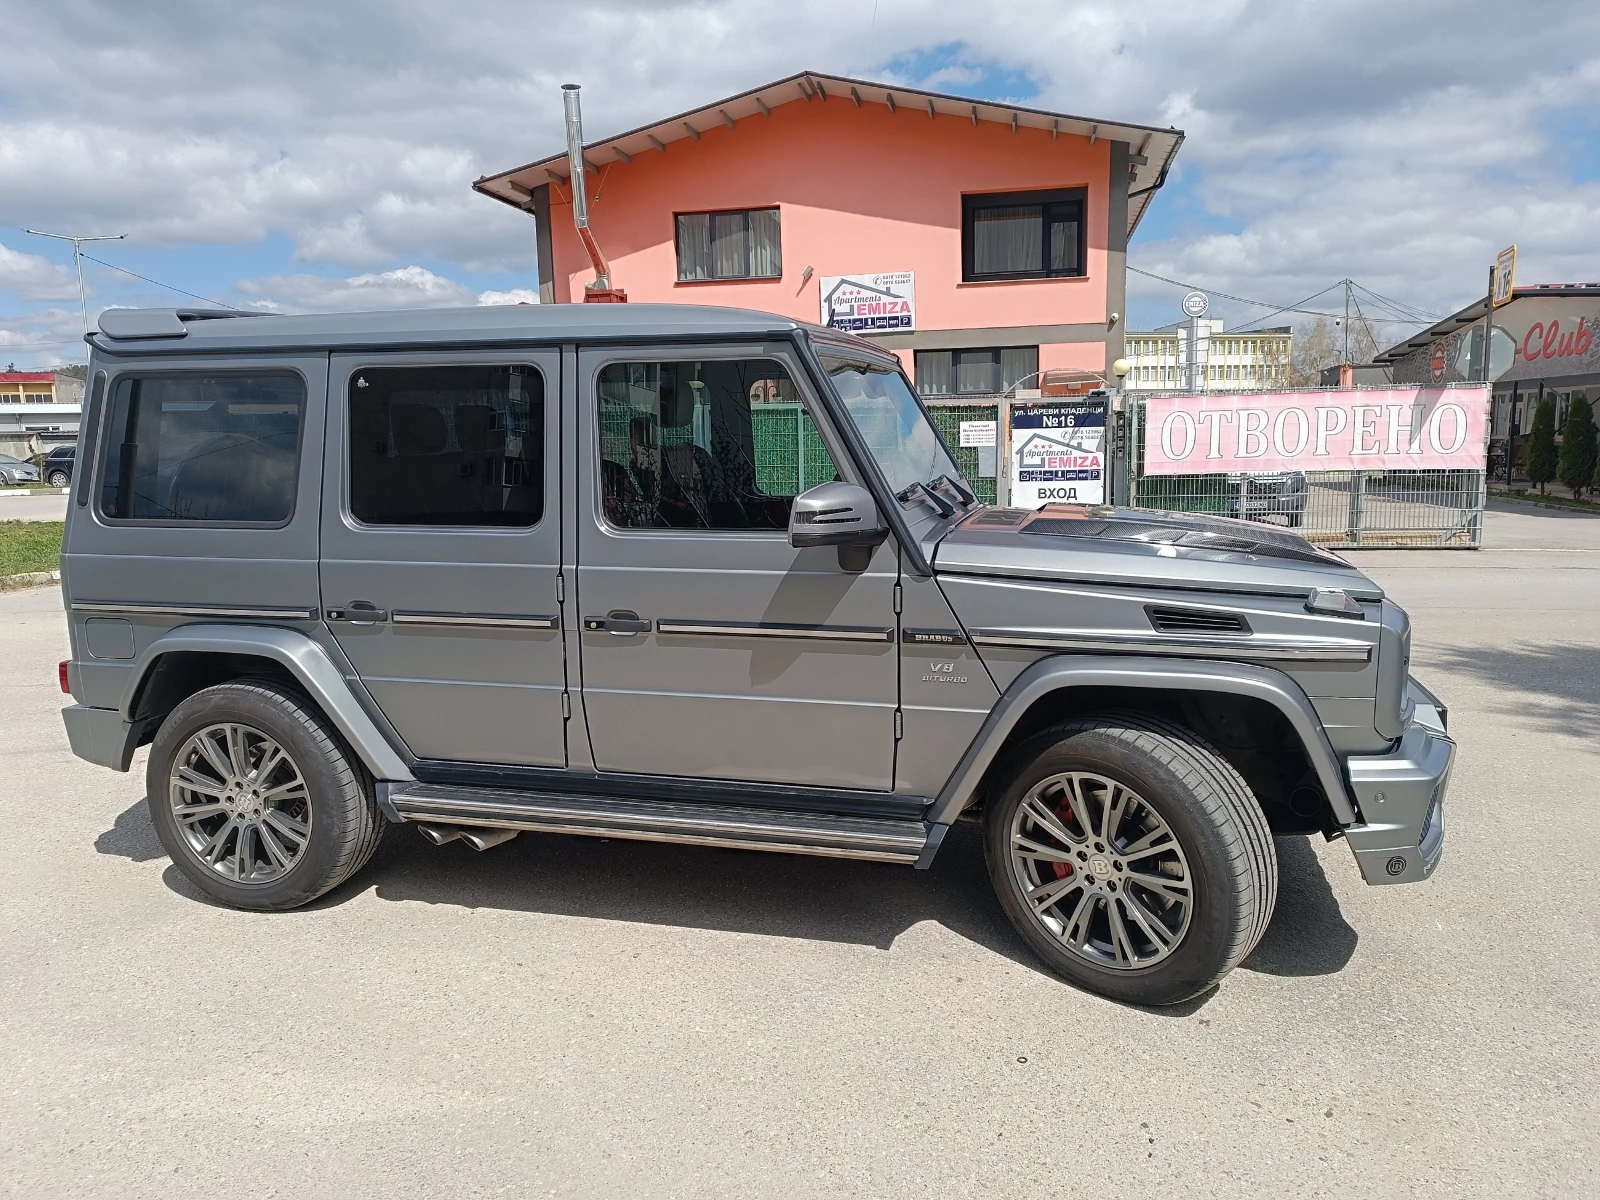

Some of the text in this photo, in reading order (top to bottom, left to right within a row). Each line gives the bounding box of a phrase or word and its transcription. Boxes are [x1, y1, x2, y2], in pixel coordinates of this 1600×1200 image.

[833, 294, 882, 306] Apartments
[856, 300, 912, 316] EMIZA
[1014, 406, 1104, 417] ул. ЦАРЕВИ КЛАДЕНЦИ
[1042, 415, 1075, 427] №16
[1160, 403, 1468, 461] ОТВОРЕНО
[1024, 449, 1073, 459] Apartments
[1047, 455, 1102, 469] EMIZA
[1038, 487, 1078, 500] ВХОД
[914, 634, 953, 642] BRABUS
[929, 662, 954, 673] V8
[921, 675, 968, 684] BITURBO
